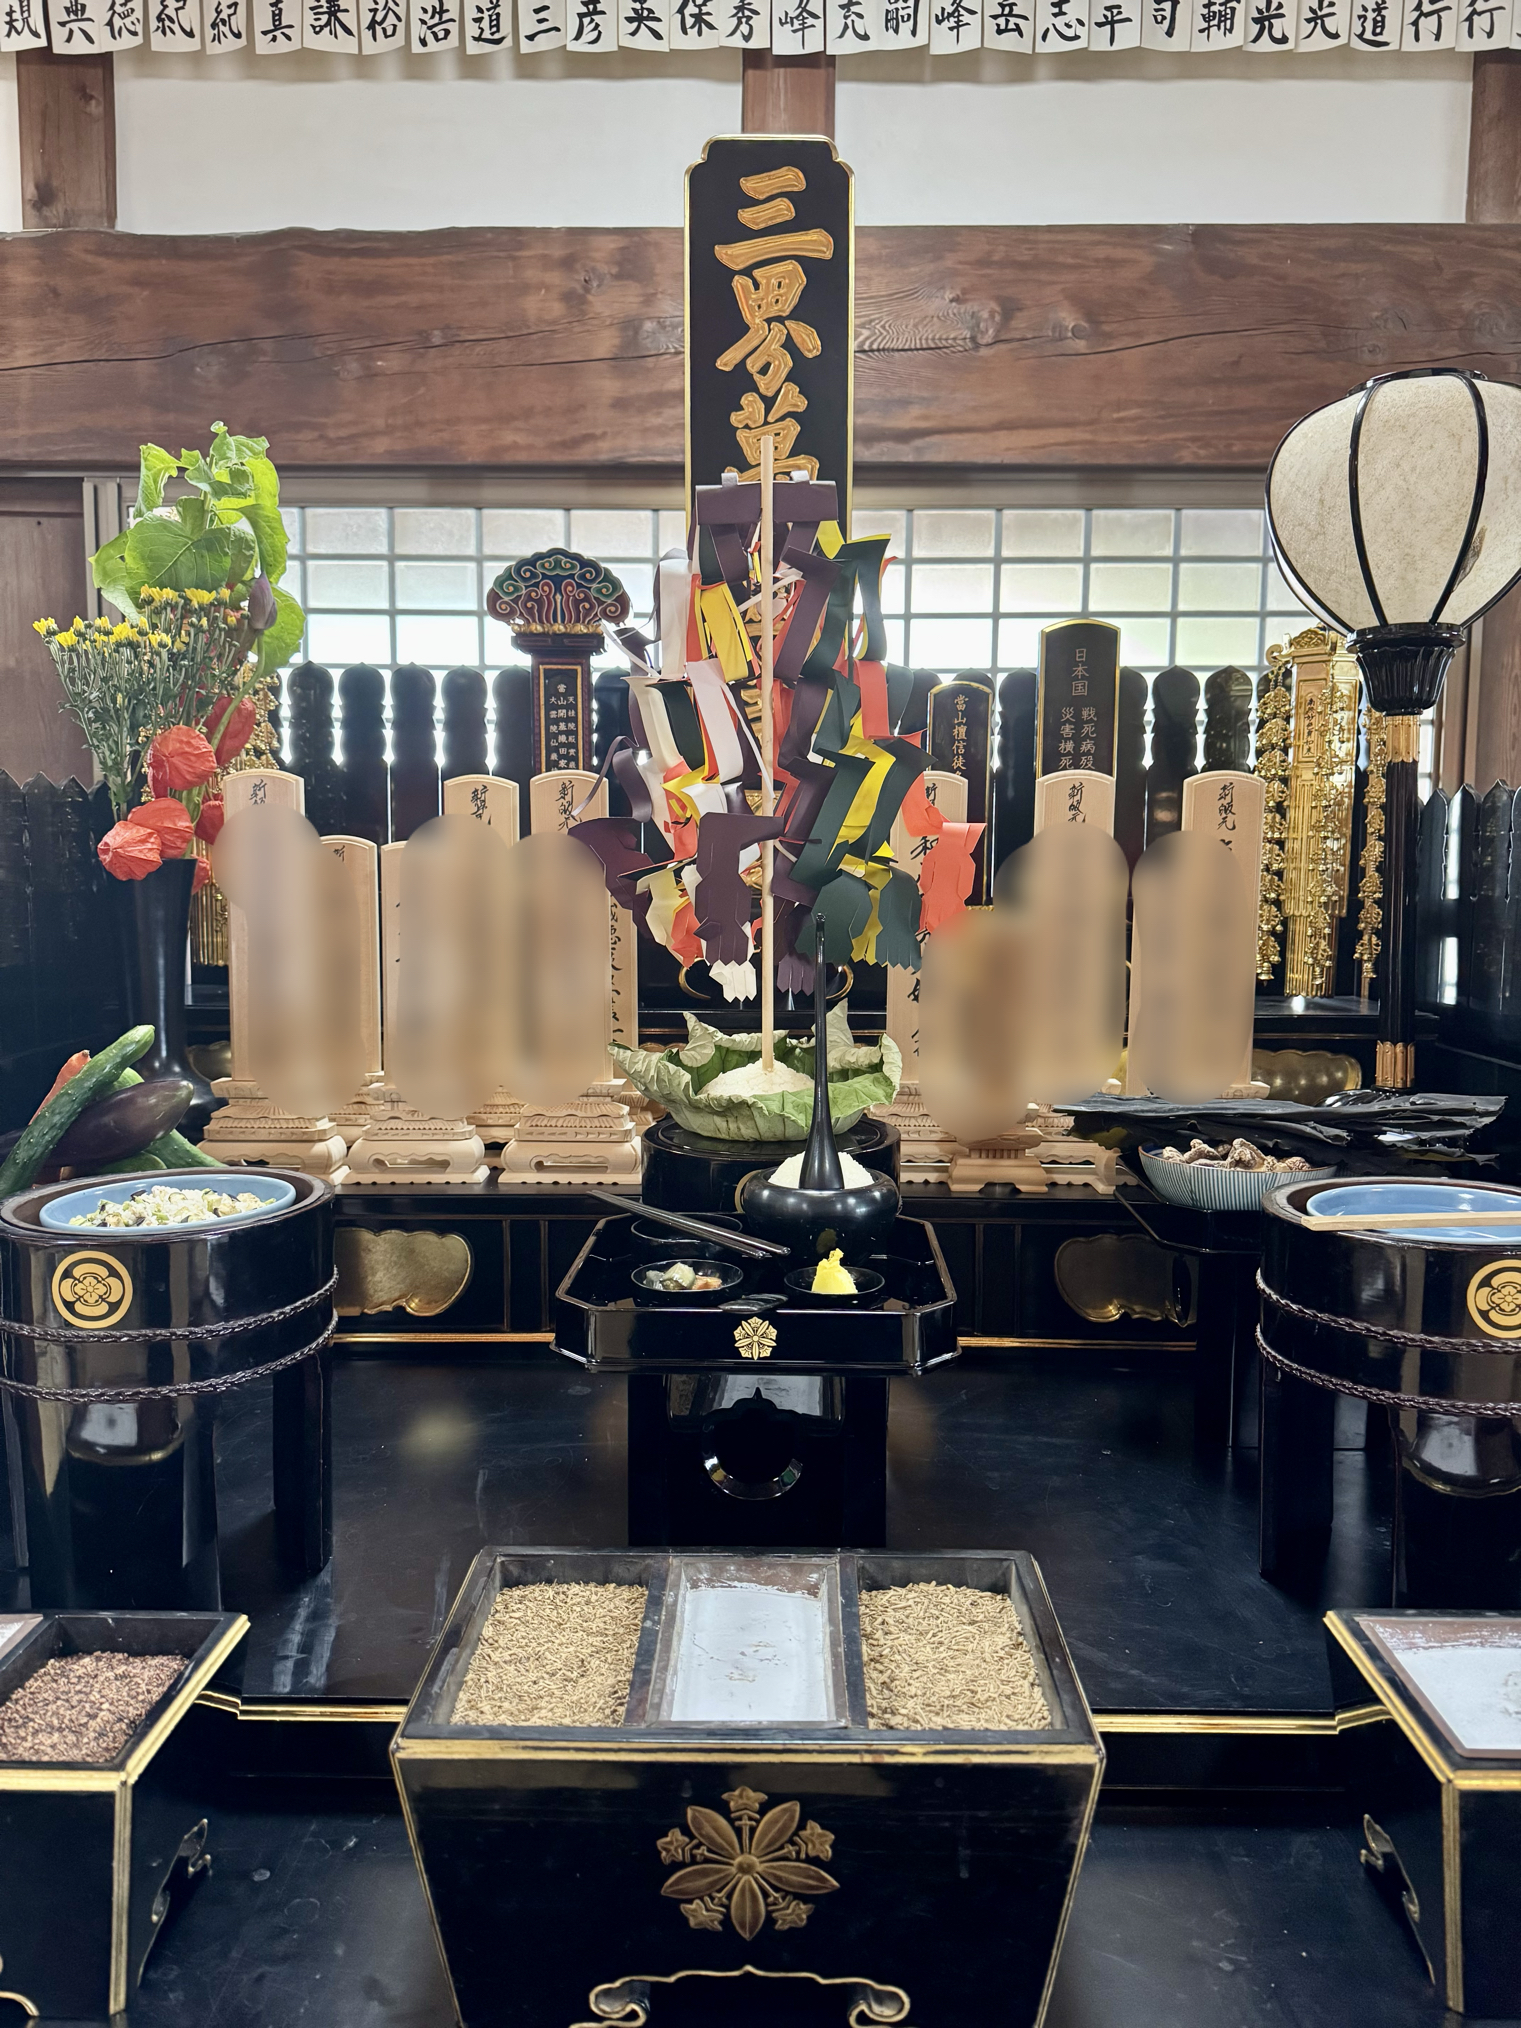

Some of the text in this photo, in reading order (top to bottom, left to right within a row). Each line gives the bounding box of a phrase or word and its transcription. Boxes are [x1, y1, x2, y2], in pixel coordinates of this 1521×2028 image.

[4, 0, 42, 38] 規
[57, 3, 95, 45] 典
[103, 0, 141, 40] 徳
[152, 0, 196, 38] 紀
[211, 1, 242, 44] 紀
[260, 0, 295, 44] 真
[308, 0, 356, 40] 謙
[364, 0, 403, 42] 裕
[418, 0, 457, 47] 浩
[471, 0, 510, 45] 道
[524, 5, 562, 42] 三
[569, 0, 607, 44] 彦
[624, 0, 664, 41] 英
[671, 0, 719, 37] 保
[725, 0, 761, 43] 秀
[778, 0, 822, 50] 峰
[884, 0, 920, 38] 嗣
[934, 0, 979, 45] 峰
[988, 1, 1030, 39] 岳
[1041, 0, 1086, 42] 志
[1094, 4, 1133, 47] 平
[1198, 0, 1241, 42] 輔
[1249, 0, 1290, 45] 光
[1301, 0, 1341, 40] 光
[1353, 0, 1392, 48] 道
[1406, 0, 1453, 43] 行
[1460, 0, 1506, 39] 行
[1071, 648, 1090, 696] 日本国
[1058, 706, 1076, 770] 災害横死
